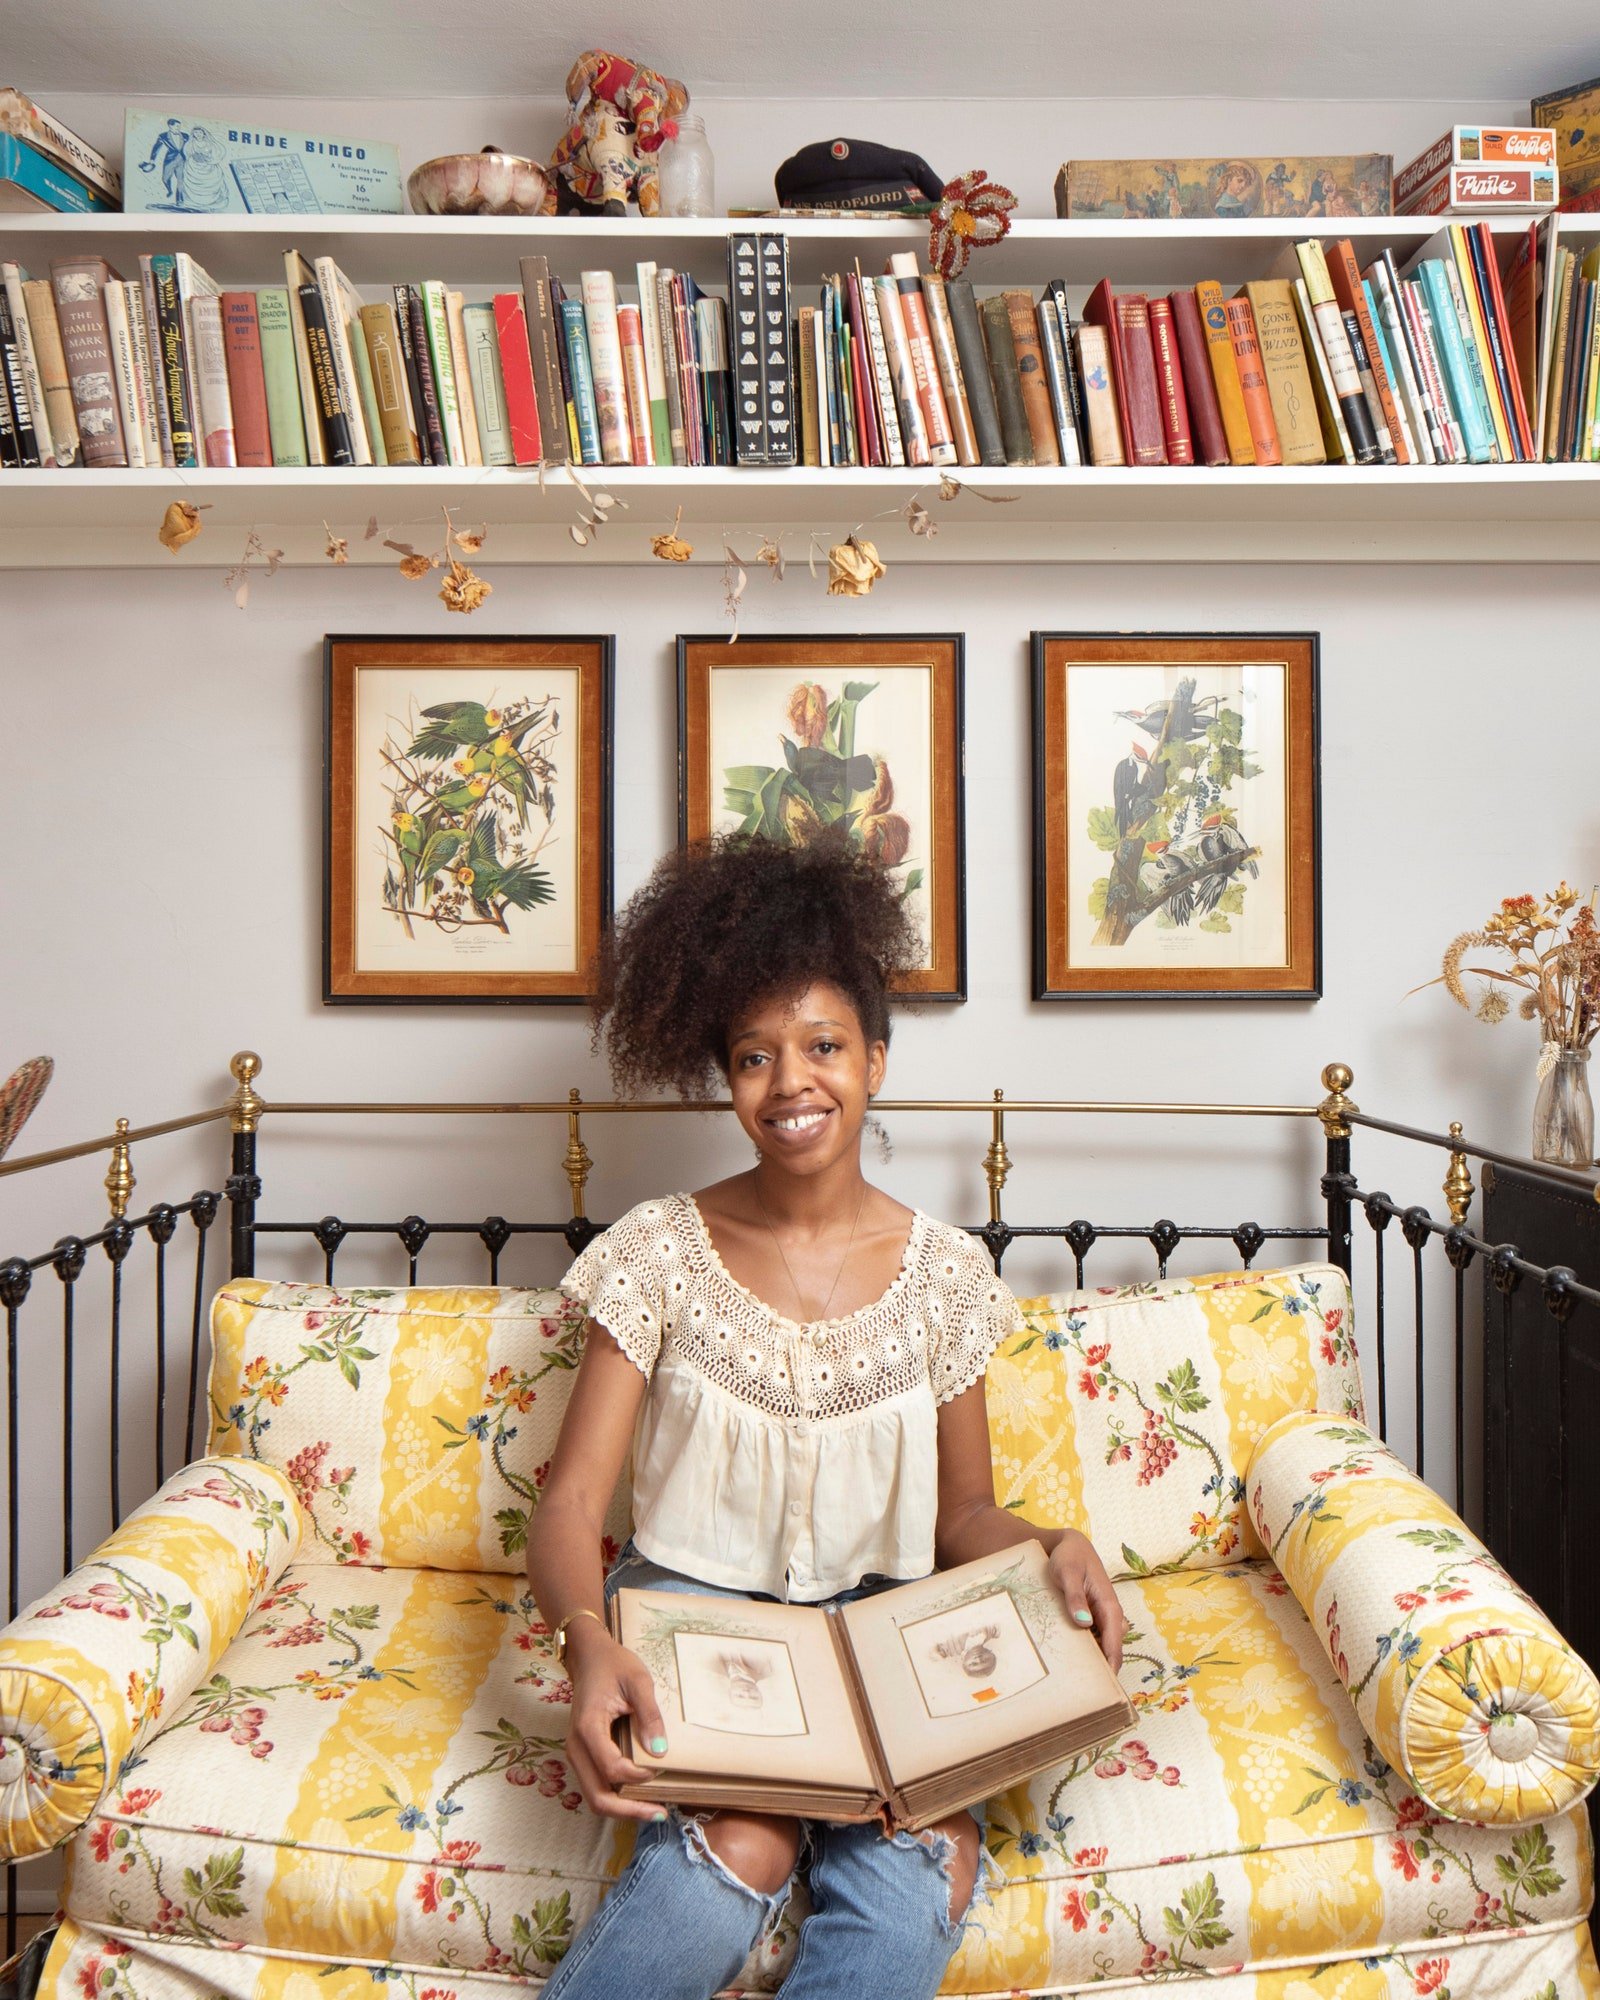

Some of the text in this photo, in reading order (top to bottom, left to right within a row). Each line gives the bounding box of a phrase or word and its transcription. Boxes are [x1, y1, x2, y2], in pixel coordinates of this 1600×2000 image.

[228, 130, 366, 160] BRIDE BINGO
[1506, 135, 1551, 158] Couple
[338, 164, 370, 174] Fascinating
[352, 194, 370, 203] People
[815, 190, 903, 209] OSLOFJORD
[1457, 175, 1516, 196] Puzzle
[1346, 256, 1360, 289] LEEMING
[1436, 272, 1444, 288] The
[124, 286, 136, 327] practically
[395, 286, 410, 329] Side Effects
[536, 279, 545, 310] Foxfire
[1438, 289, 1448, 306] Dog
[70, 311, 93, 320] THE
[1228, 304, 1251, 321] HEAD
[1262, 313, 1291, 328] GONE
[1560, 312, 1568, 341] Oregon
[64, 322, 104, 335] FAMILY
[68, 336, 102, 348] MARK
[134, 285, 142, 300] How
[140, 346, 151, 386] practically
[151, 328, 159, 356] Artificial
[330, 320, 339, 338] book
[415, 325, 425, 345] RISE
[737, 242, 762, 434] ART USA NOW
[764, 242, 790, 434] ART USA NOW
[1232, 321, 1253, 336] LINE
[1262, 328, 1280, 337] WITH
[69, 349, 107, 362] TWAIN
[120, 337, 128, 362] survival
[334, 339, 341, 348] of
[419, 348, 427, 360] UP
[431, 290, 456, 415] THE PORTOFINO P.T.A.
[667, 327, 676, 371] CHURCHES
[802, 310, 812, 379] Existentialism
[1235, 339, 1258, 356] LADY
[1264, 338, 1298, 351] WIND
[1360, 309, 1372, 330] FUN
[1367, 334, 1379, 359] WITH
[1374, 361, 1389, 392] MAGIC
[16, 316, 41, 413] Builders of Milwaukee
[162, 321, 187, 424] Flower Arrangement
[308, 326, 332, 418] FLOWER ARRANGERS
[316, 326, 341, 414] ARTS AND CRAFTS FOR
[336, 348, 345, 369] lawns
[421, 361, 430, 380] AND
[909, 337, 929, 391] RUSSIA
[1466, 345, 1483, 387] More Riddles
[5, 342, 30, 424] FURNITURE
[121, 363, 131, 383] guide
[1158, 323, 1179, 433] MODERN SEWING METHODS
[342, 384, 355, 422] landscape
[1068, 371, 1082, 415] Fitzgibbon
[127, 393, 136, 423] teachers
[928, 394, 943, 441] PANTHEON
[1388, 414, 1402, 443] STOKES
